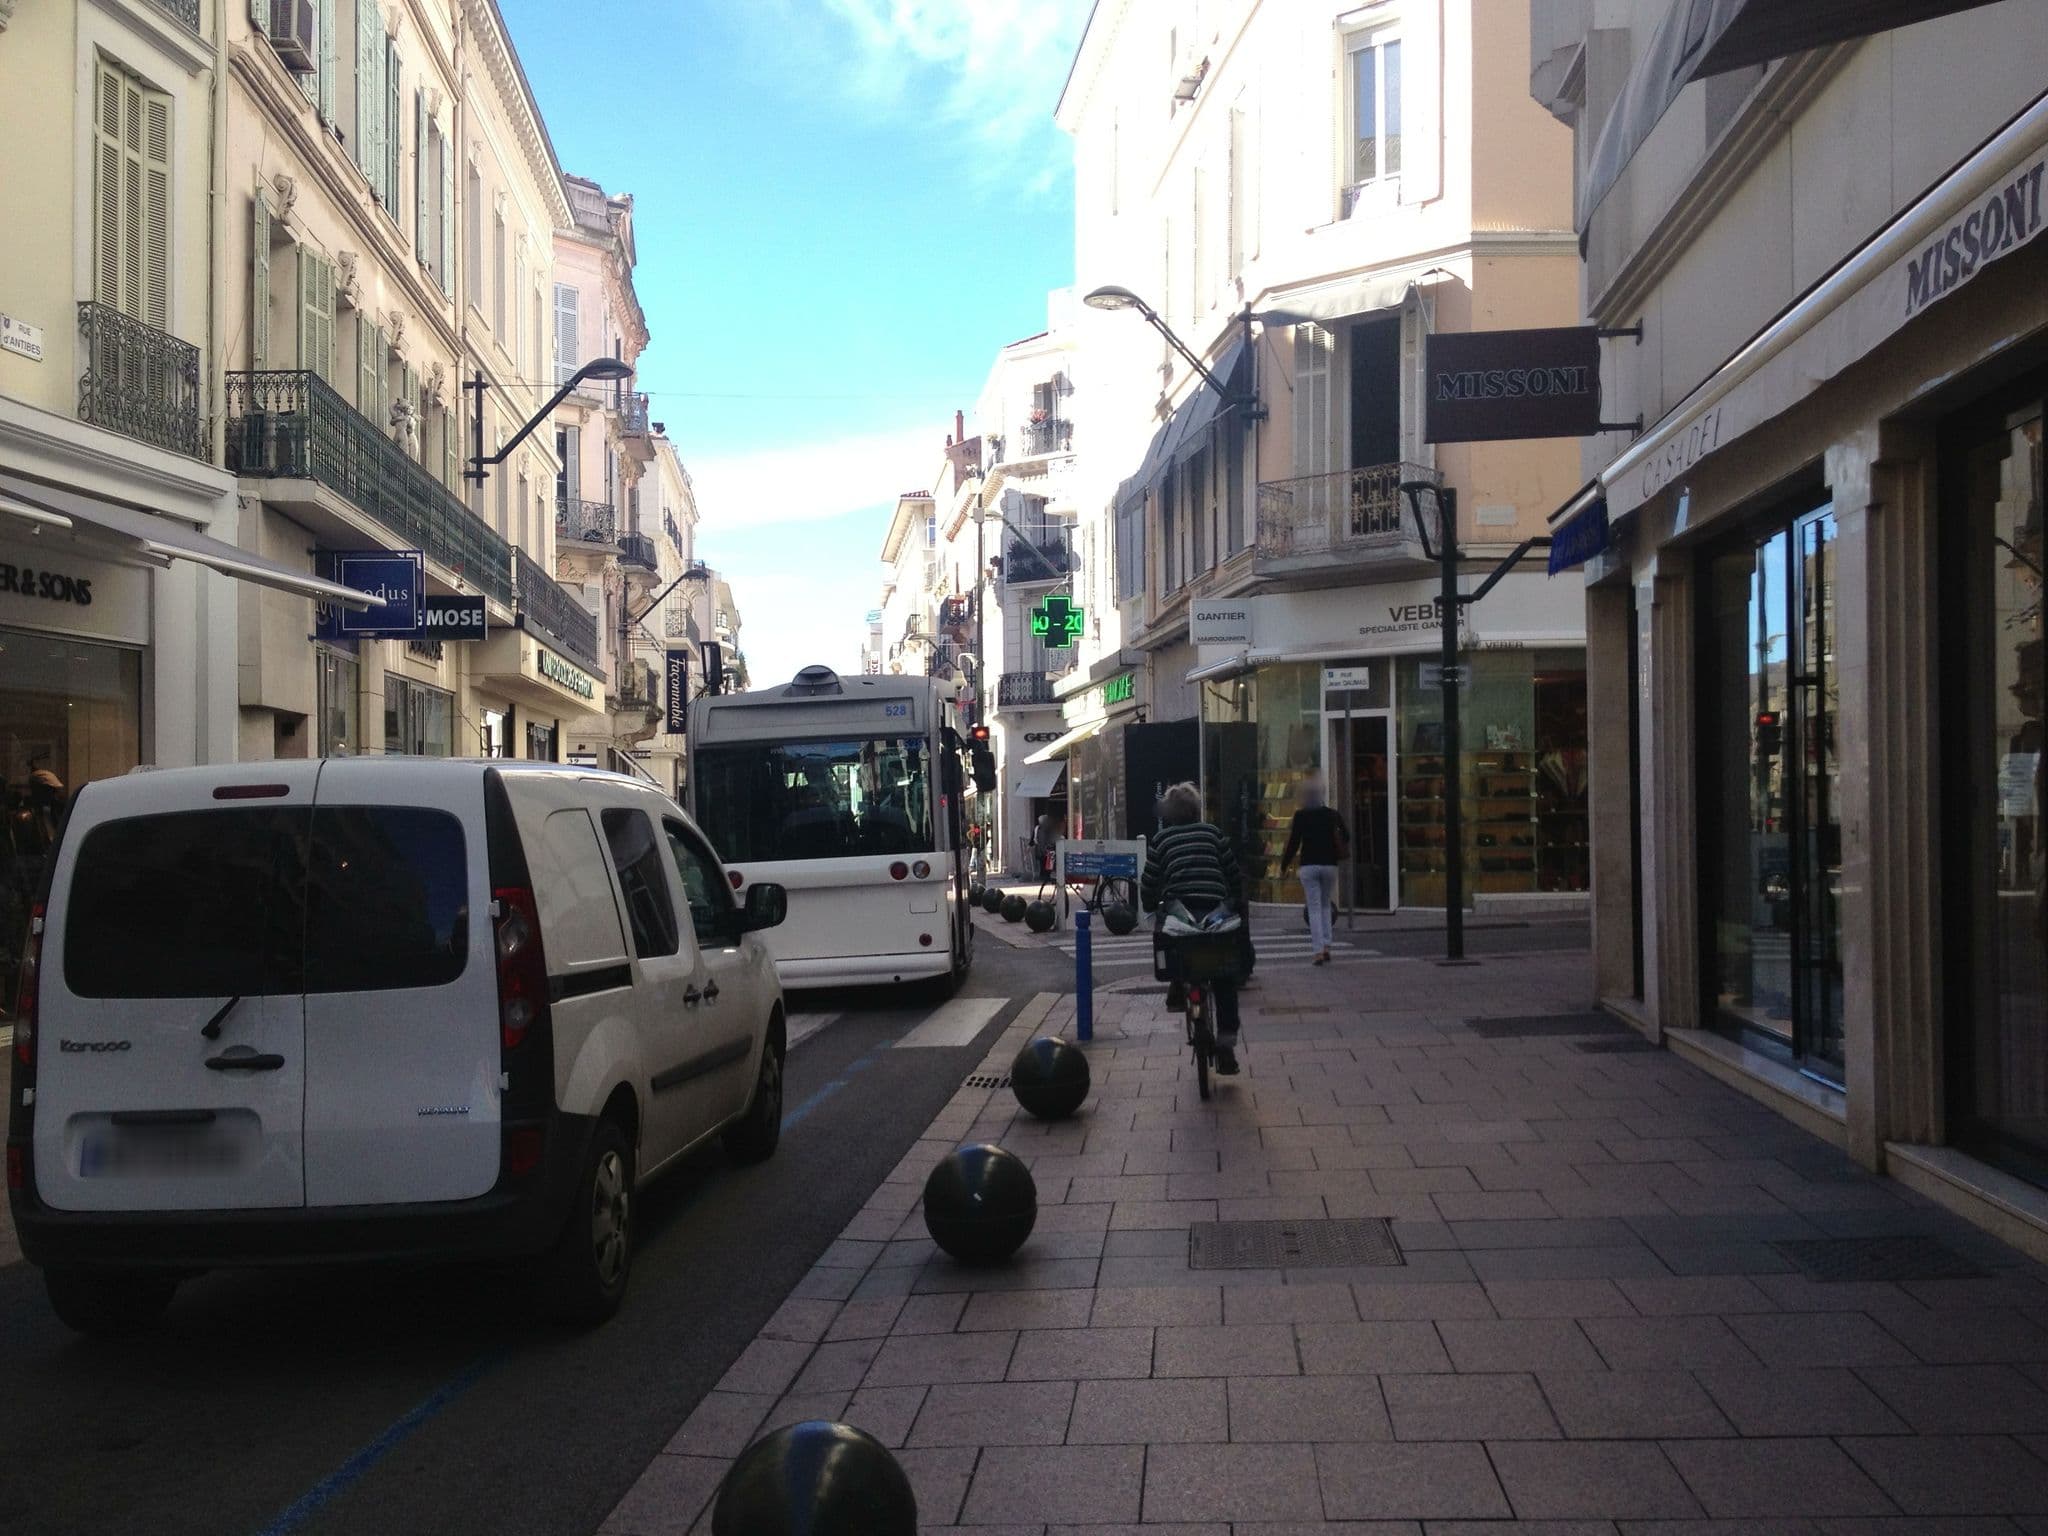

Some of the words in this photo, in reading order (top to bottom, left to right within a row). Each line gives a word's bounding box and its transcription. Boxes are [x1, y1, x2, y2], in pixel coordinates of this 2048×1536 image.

[1905, 161, 2045, 316] MISSONI
[1436, 366, 1588, 400] MISSONI
[1642, 408, 1722, 499] CASADEI
[21, 568, 37, 597] &
[39, 571, 92, 606] SONS
[364, 582, 408, 600] odus
[1196, 611, 1246, 621] GANTIER
[1359, 622, 1419, 635] SPECIALISTE
[1422, 618, 1465, 630] GANR
[669, 657, 686, 729] Façonnable
[885, 703, 906, 717] 528
